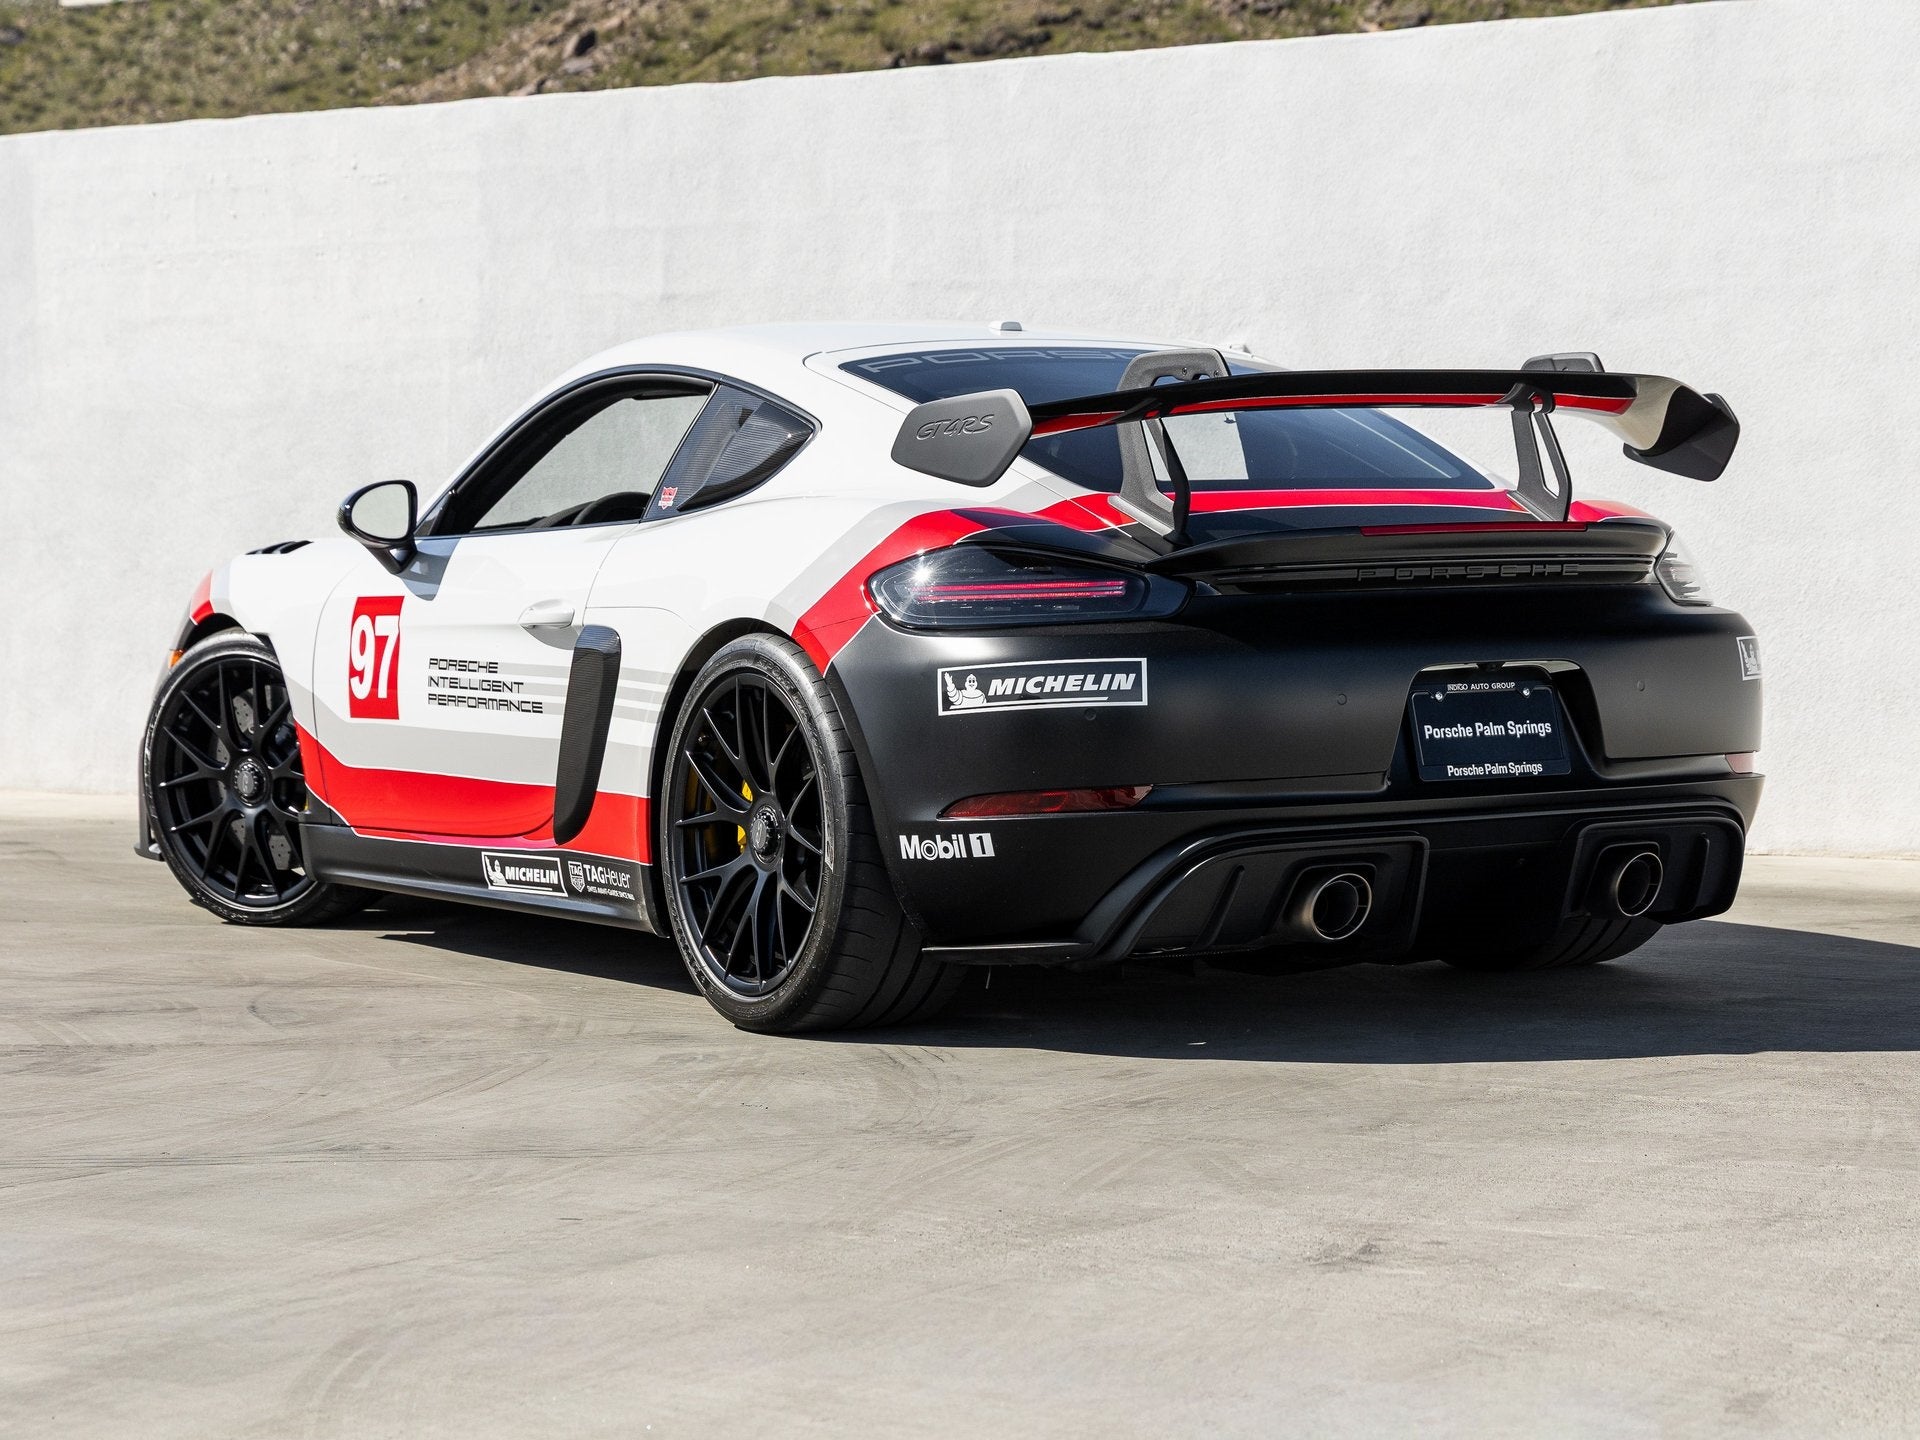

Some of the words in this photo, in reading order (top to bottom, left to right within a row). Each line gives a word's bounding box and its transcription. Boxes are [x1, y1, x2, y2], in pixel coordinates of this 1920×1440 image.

[1357, 563, 1579, 582] PORSCHE
[350, 614, 399, 700] 97
[429, 658, 499, 674] PORSCHE
[428, 676, 524, 694] INTELLIGENT
[987, 673, 1136, 697] MICHELIN
[1447, 683, 1468, 691] INDIGO
[1470, 682, 1490, 691] AUTO
[1491, 682, 1516, 690] GROUP
[428, 693, 544, 714] PERFORMANCE
[1424, 724, 1474, 740] Porsche
[1475, 722, 1506, 737] Palm
[1507, 720, 1552, 738] Springs
[1447, 765, 1485, 777] Porsche
[1485, 763, 1508, 774] Palm
[1508, 762, 1543, 776] Springs
[899, 834, 967, 860] Mobil
[505, 866, 559, 884] MICHELIN
[569, 865, 583, 876] TAG
